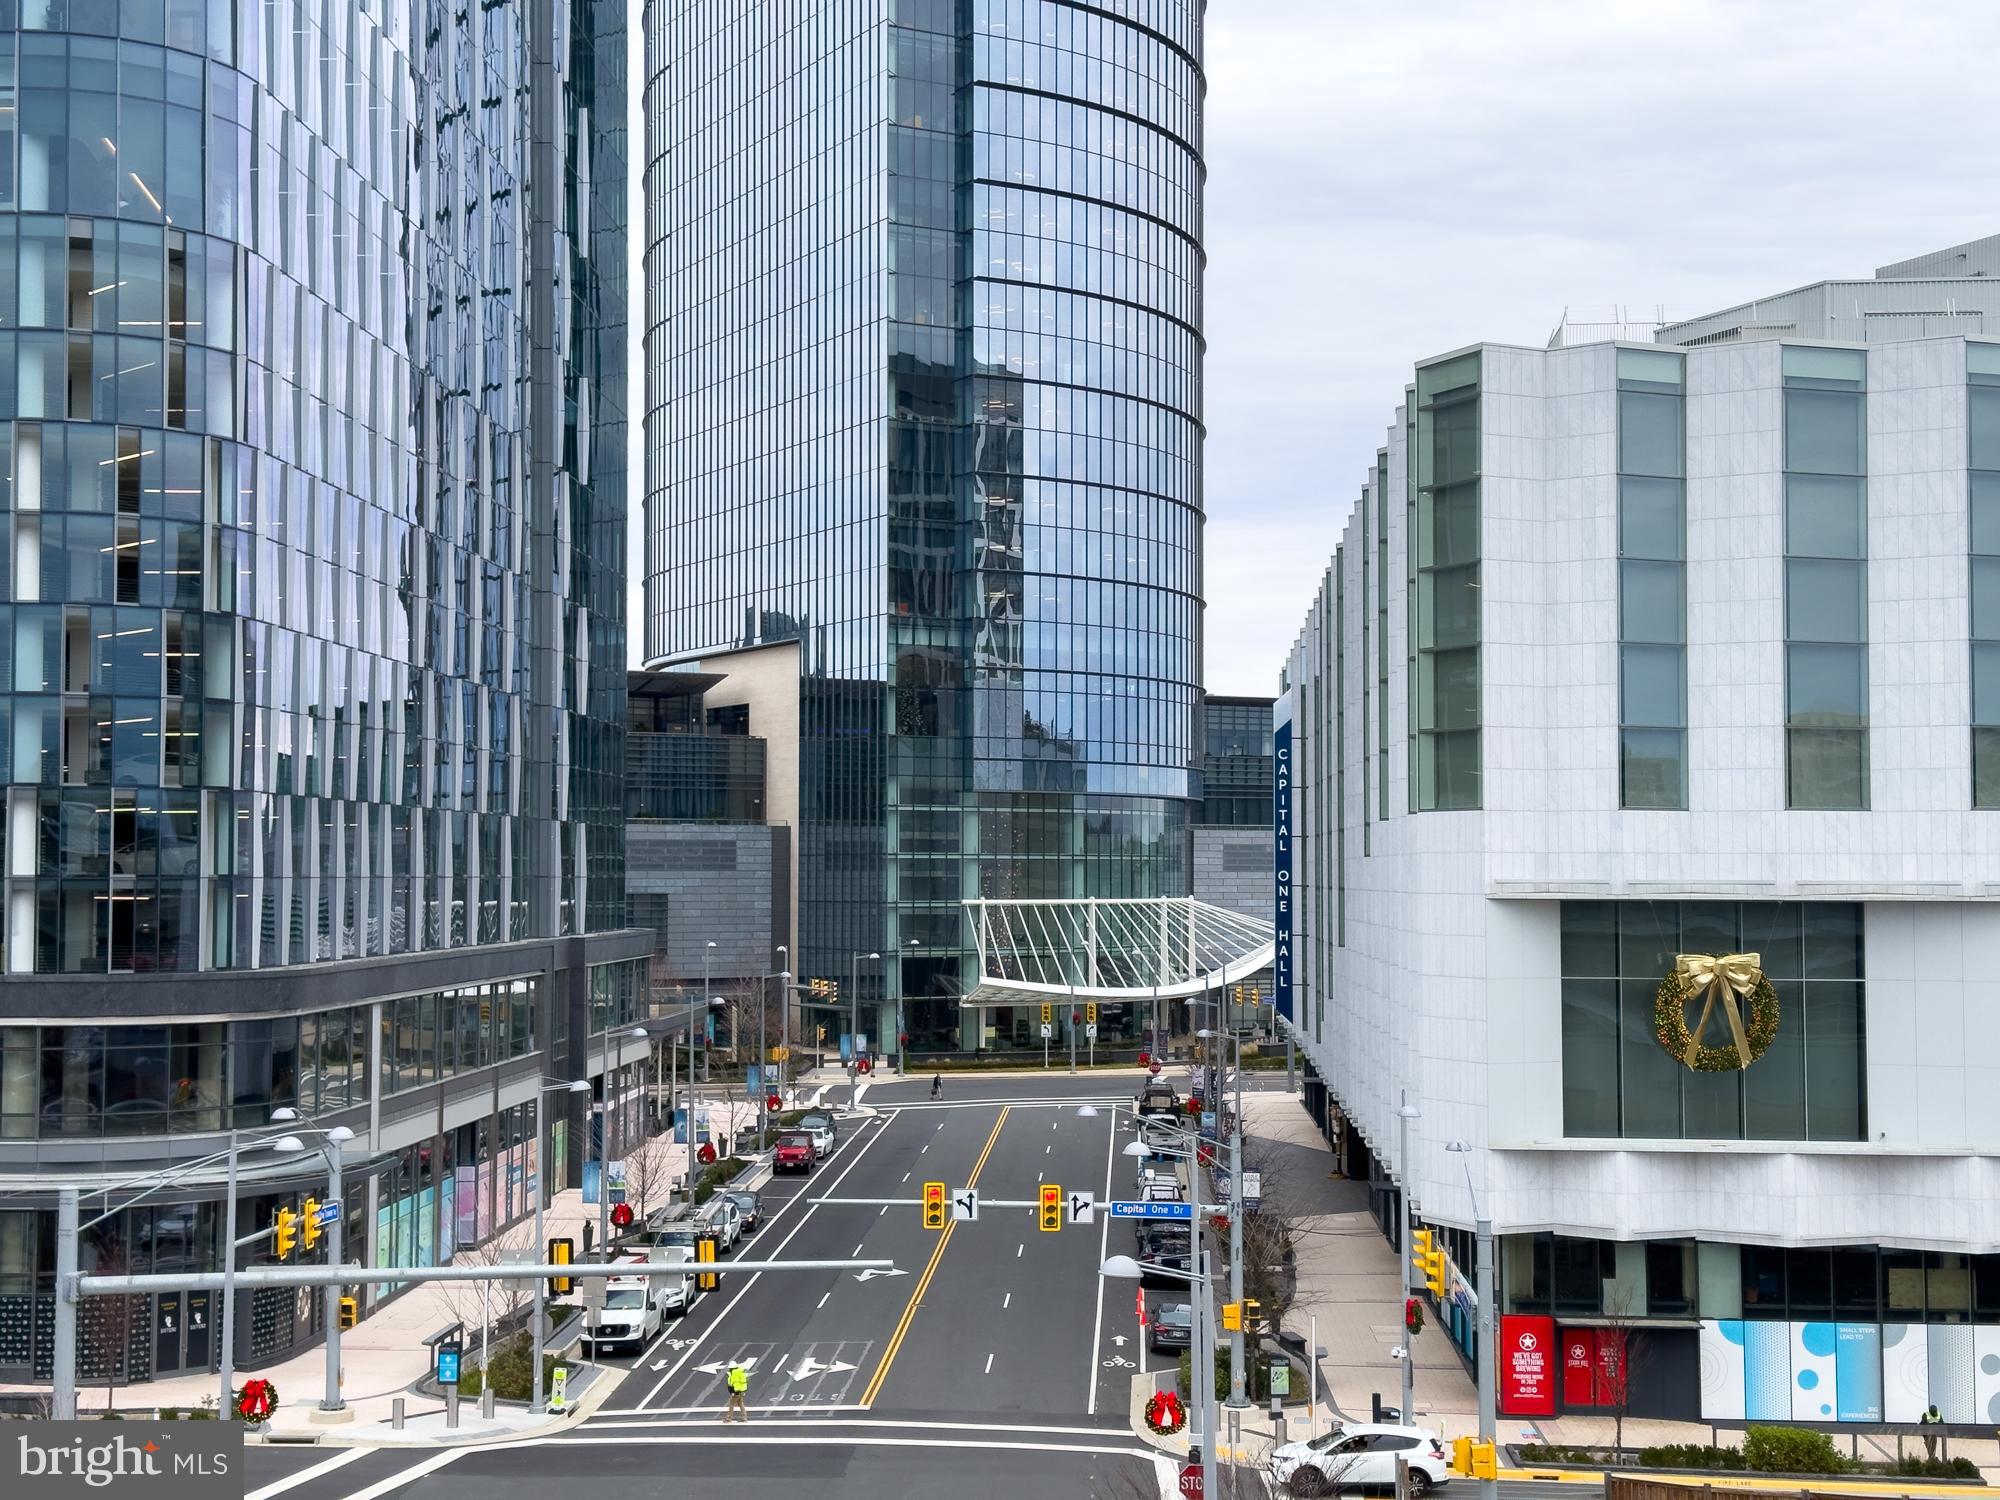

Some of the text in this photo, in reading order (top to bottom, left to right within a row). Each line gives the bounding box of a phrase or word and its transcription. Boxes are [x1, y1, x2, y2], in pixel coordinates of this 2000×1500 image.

[1278, 748, 1289, 987] CAPITAL ONE HALL
[1117, 1204, 1183, 1214] Capital One Dr
[1181, 1476, 1203, 1490] STO
